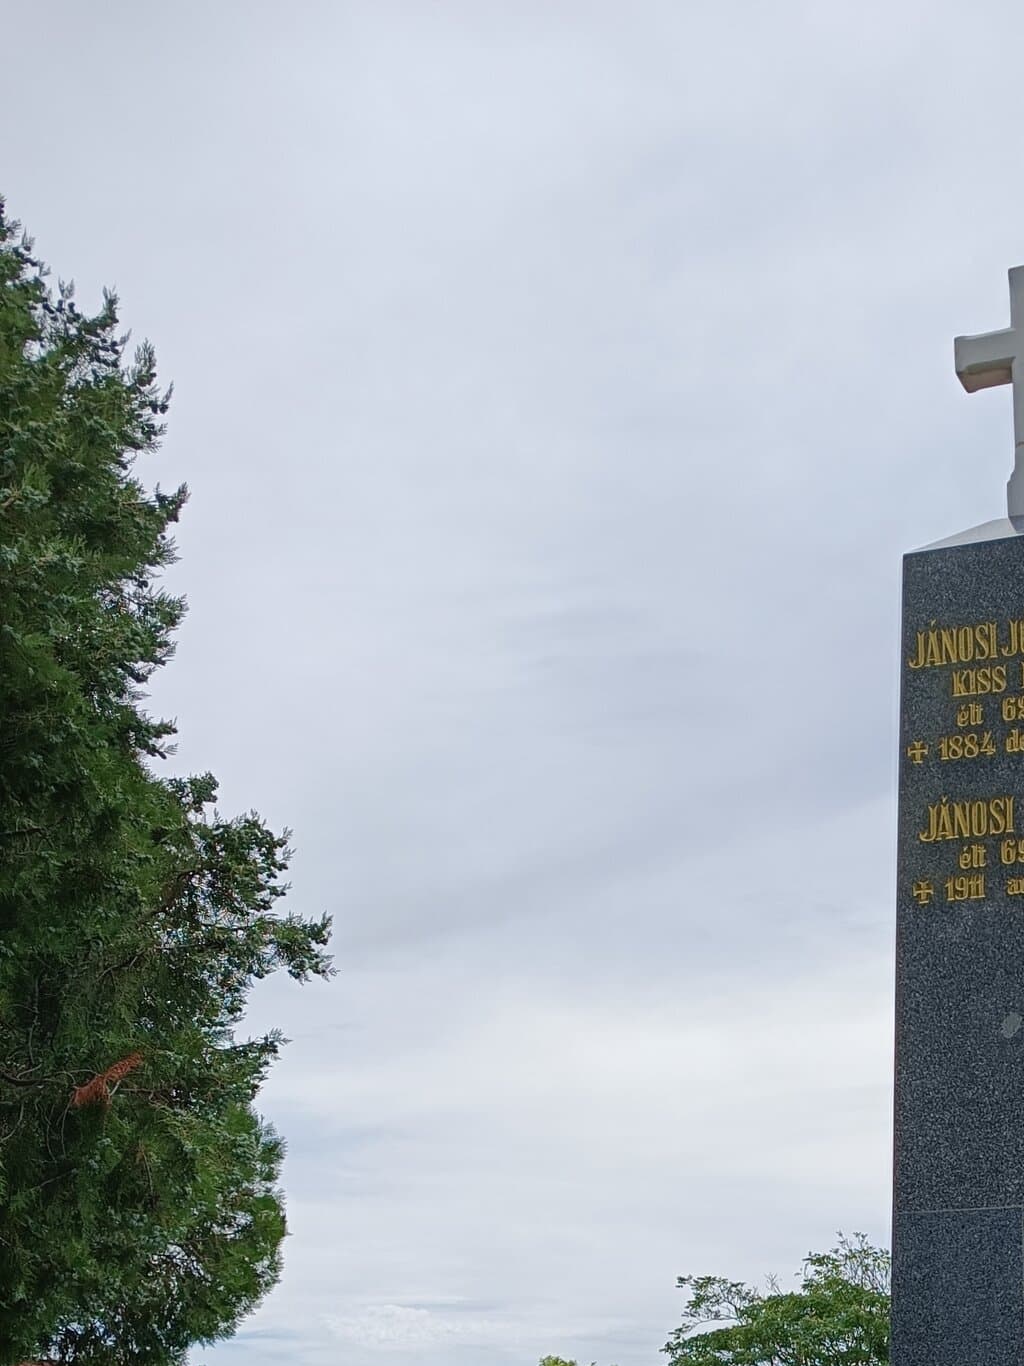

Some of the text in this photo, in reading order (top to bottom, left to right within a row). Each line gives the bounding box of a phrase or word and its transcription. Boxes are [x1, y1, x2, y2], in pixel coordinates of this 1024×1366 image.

[909, 619, 998, 669] JÁNOSI
[952, 665, 1007, 697] KISS
[957, 703, 983, 727] élt
[938, 731, 996, 761] 1884
[919, 795, 1015, 842] JÁNOSI
[959, 844, 987, 870] élt
[945, 874, 986, 901] 1911
